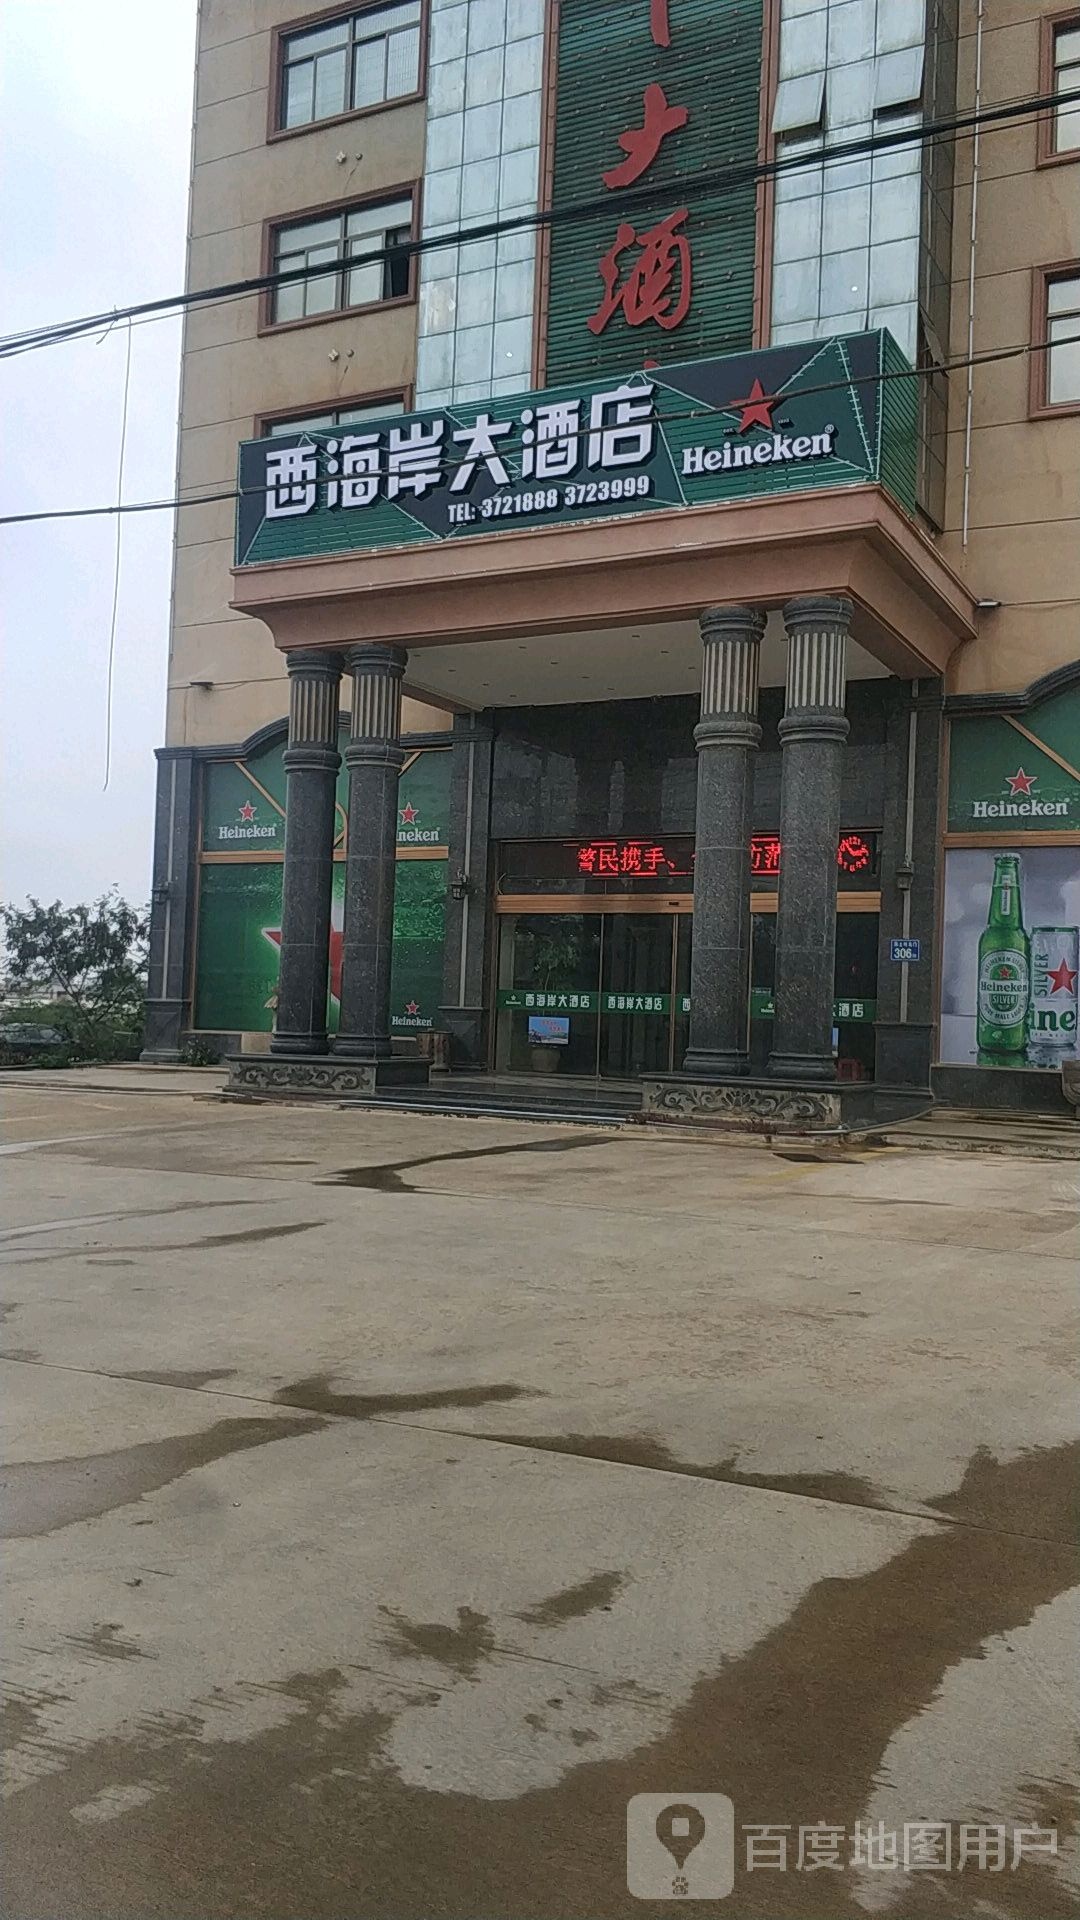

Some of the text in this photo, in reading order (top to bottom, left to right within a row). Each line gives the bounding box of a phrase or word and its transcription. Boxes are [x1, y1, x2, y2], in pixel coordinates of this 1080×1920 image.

[265, 383, 657, 518] 西海岸大酒店
[682, 425, 833, 474] Heineken
[448, 475, 650, 523] TEL: 3721888 3723999
[973, 800, 1069, 818] Heineken
[218, 824, 276, 840] Heineken
[397, 827, 440, 842] neken
[893, 947, 917, 959] 306
[1034, 953, 1048, 998] SILVER
[981, 981, 1028, 993] Heineken
[525, 993, 590, 1008] 西海岸大酒店
[607, 996, 663, 1010] 西海岸大酒店
[391, 1015, 433, 1027] Heineken
[1028, 1002, 1077, 1032] ine
